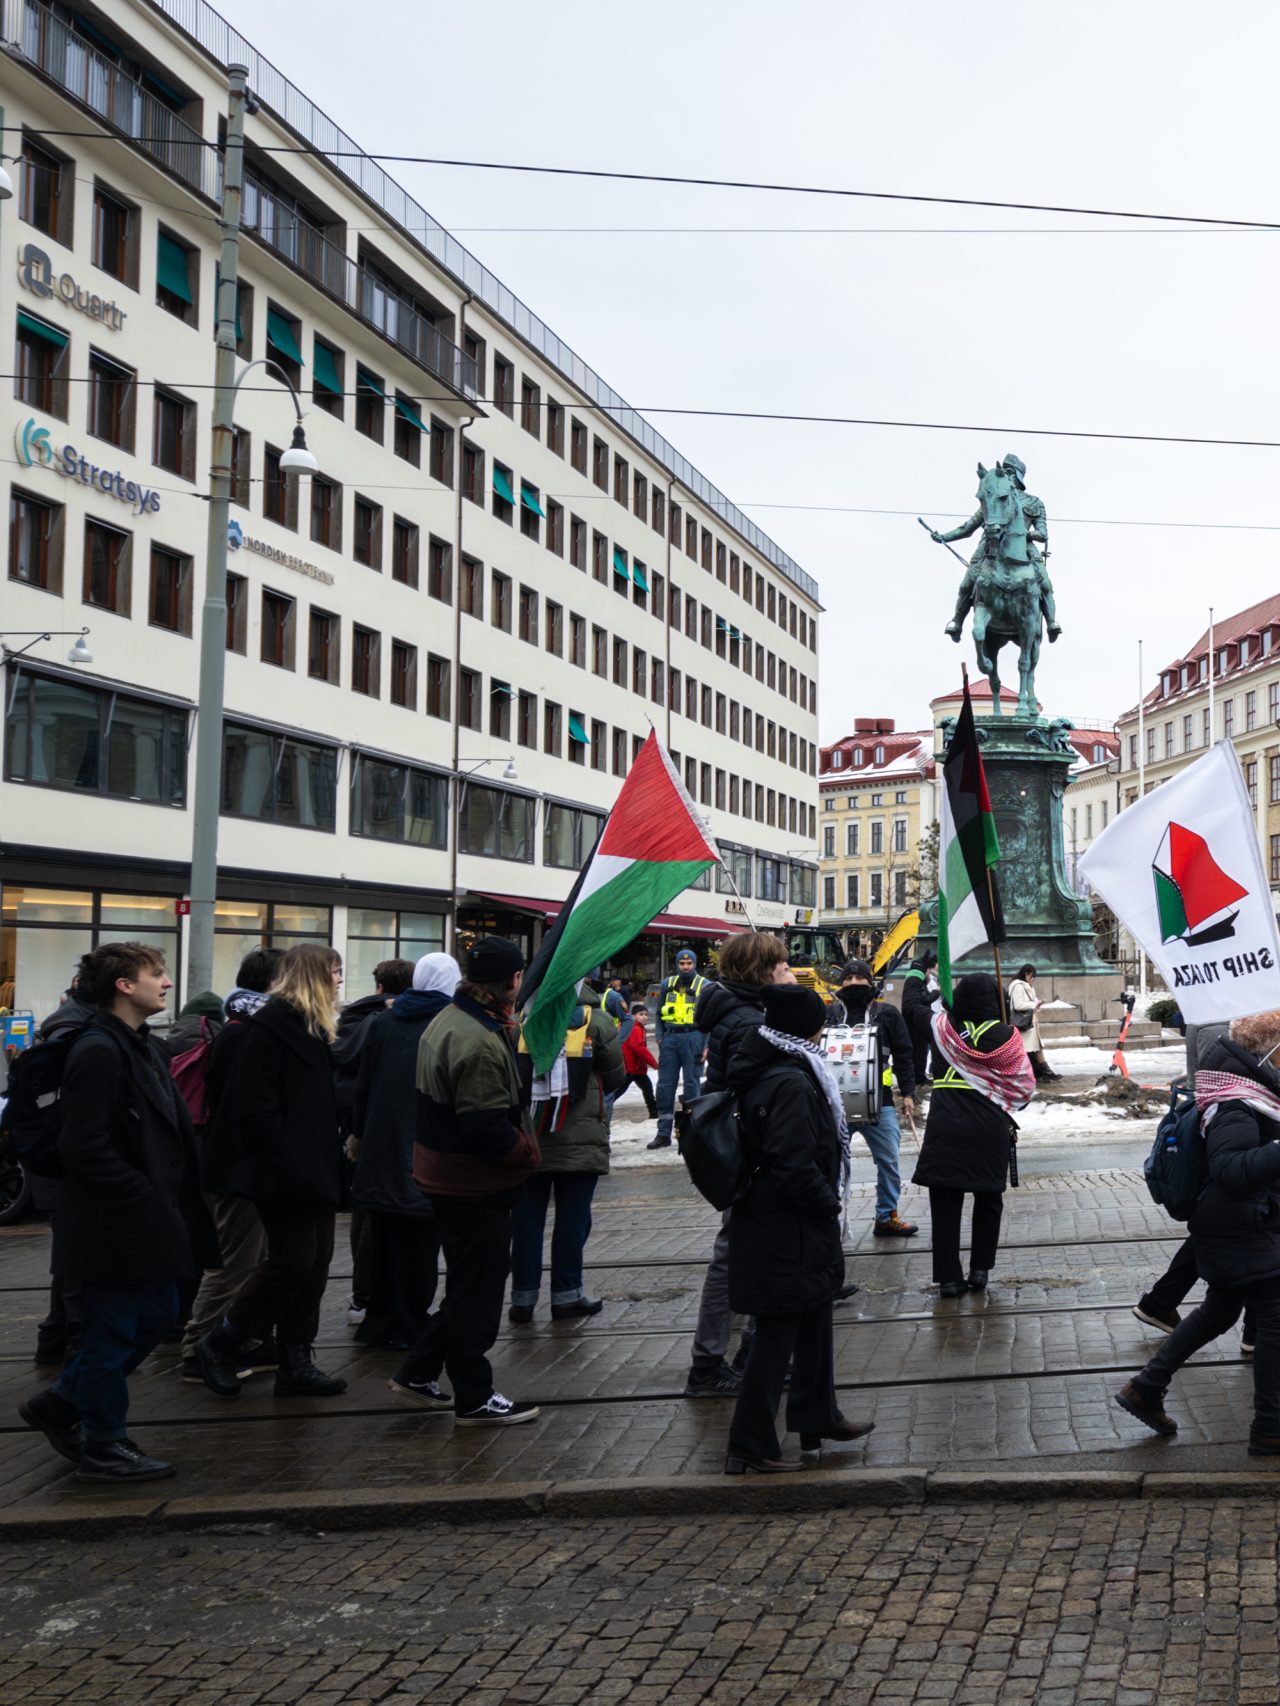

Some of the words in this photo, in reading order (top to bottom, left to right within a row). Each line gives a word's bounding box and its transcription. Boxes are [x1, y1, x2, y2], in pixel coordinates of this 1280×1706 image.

[60, 273, 127, 331] Quartr
[62, 445, 161, 515] Stratsys
[247, 536, 288, 564] NORDISK
[180, 903, 186, 912] 8
